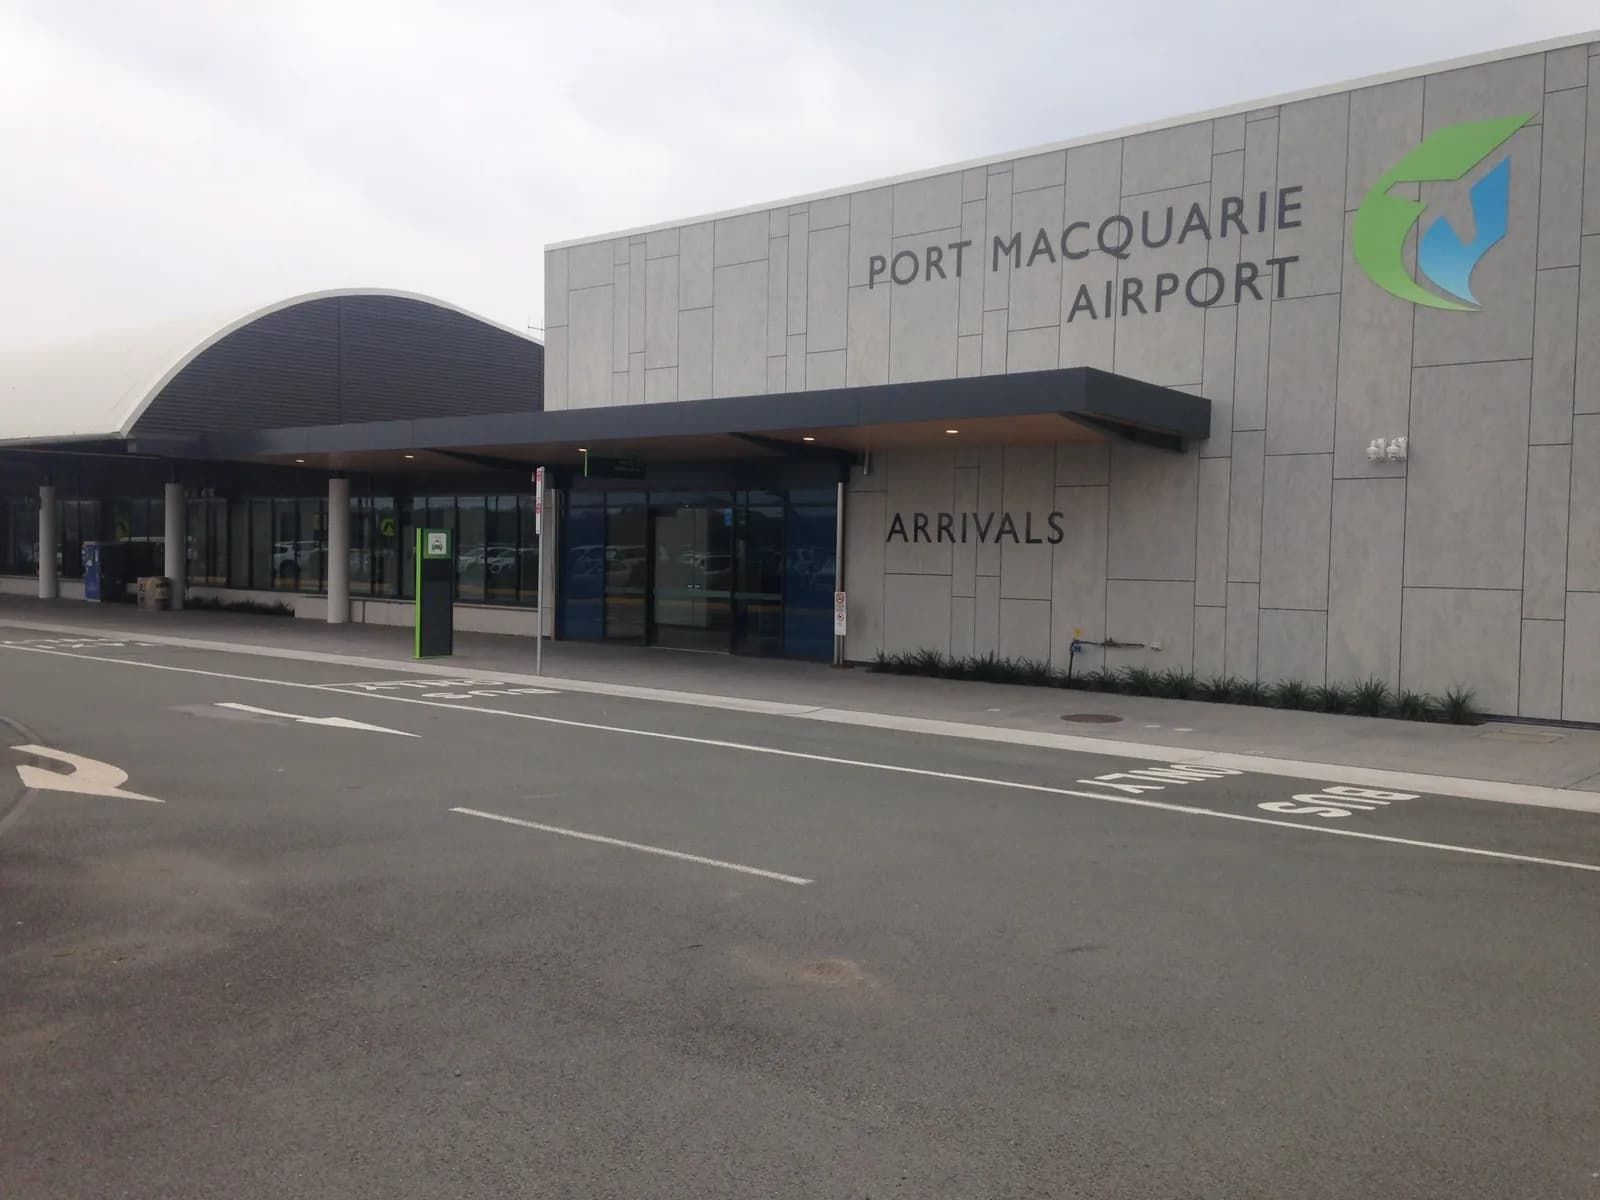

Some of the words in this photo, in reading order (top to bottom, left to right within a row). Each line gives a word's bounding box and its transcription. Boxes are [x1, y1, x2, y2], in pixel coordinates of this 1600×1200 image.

[869, 240, 972, 289] PORT
[992, 185, 1303, 273] MACQUARIE
[1067, 255, 1300, 323] AIRPORT
[886, 511, 1065, 545] ARRIVALS
[1075, 764, 1243, 794] ONLY
[1257, 785, 1421, 817] BUS
